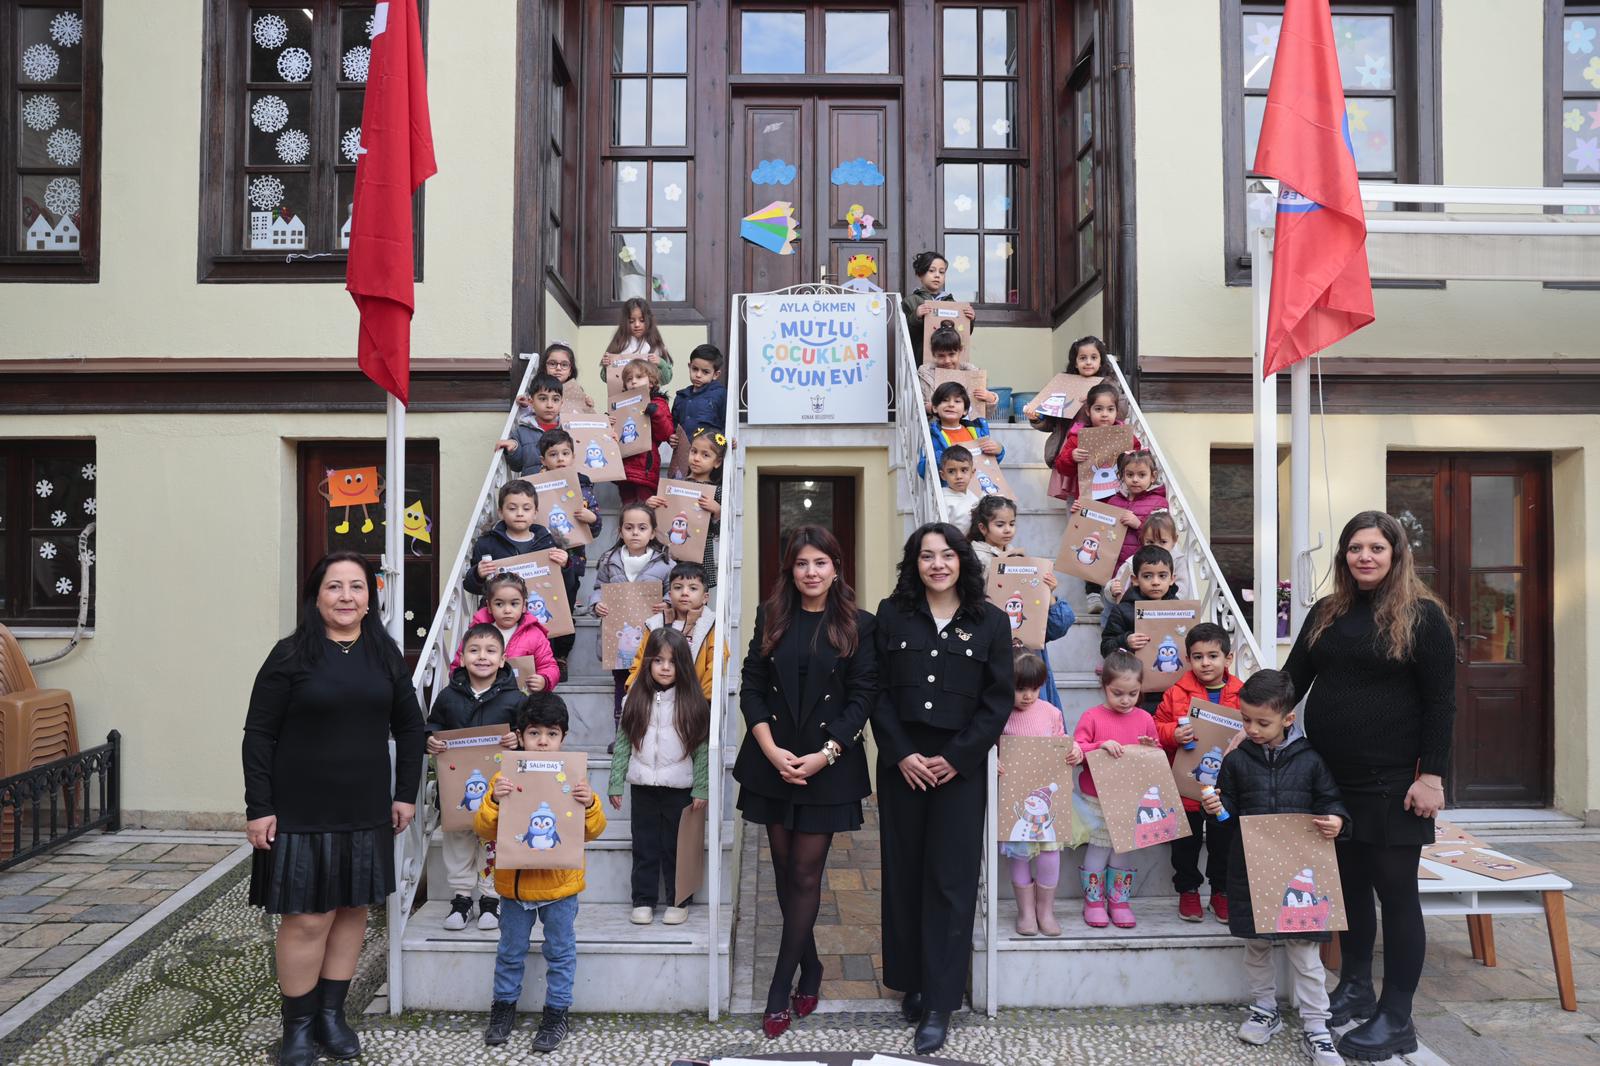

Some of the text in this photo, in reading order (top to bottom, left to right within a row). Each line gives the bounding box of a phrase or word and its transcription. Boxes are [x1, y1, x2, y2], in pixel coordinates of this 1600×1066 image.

[779, 300, 856, 313] AYLA ÖKMEN
[780, 319, 853, 339] MUTLU
[762, 343, 869, 365] ÇOCUKLAR
[770, 362, 863, 387] OYUN EVİ
[1232, 721, 1243, 729] AKY
